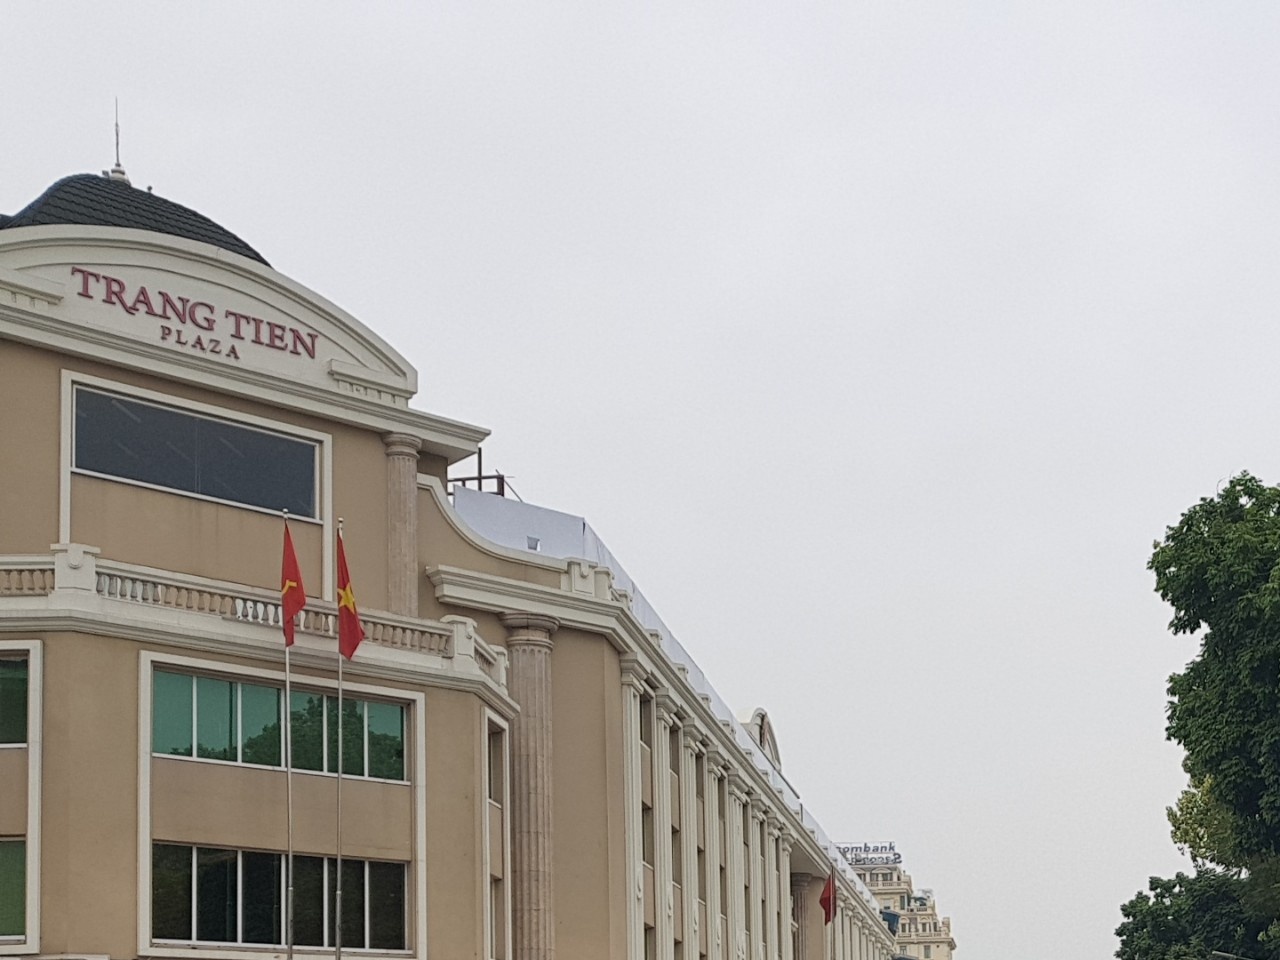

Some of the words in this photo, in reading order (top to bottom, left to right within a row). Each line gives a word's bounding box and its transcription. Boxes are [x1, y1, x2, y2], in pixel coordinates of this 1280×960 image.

[71, 266, 216, 332] TRANG
[225, 309, 318, 359] TIEN
[160, 325, 240, 359] PLAZA
